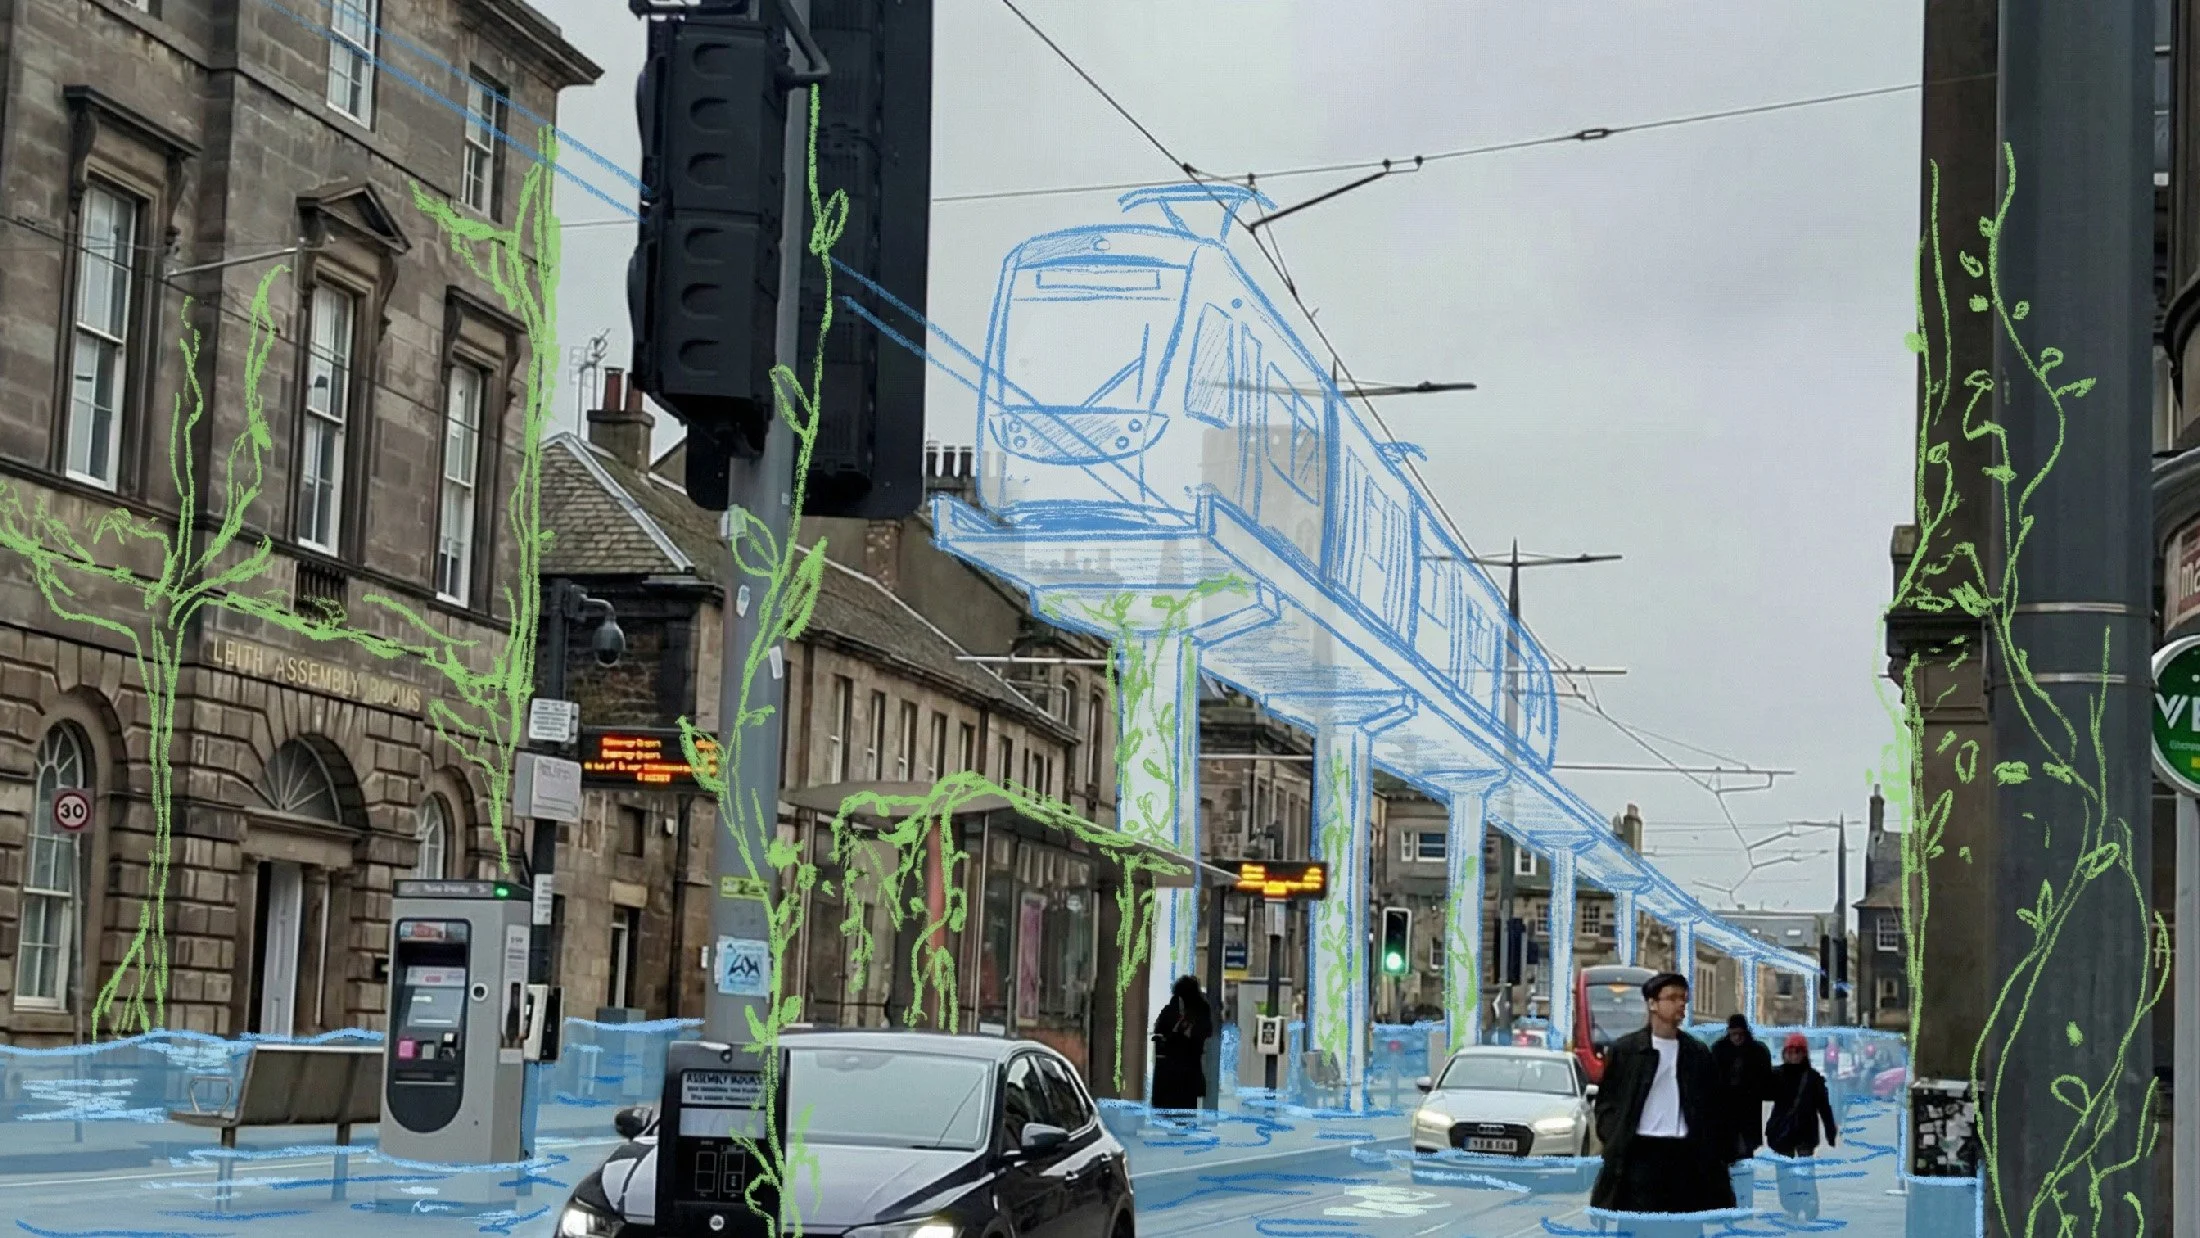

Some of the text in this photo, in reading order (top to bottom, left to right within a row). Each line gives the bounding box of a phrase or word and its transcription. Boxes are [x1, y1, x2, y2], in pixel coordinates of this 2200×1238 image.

[213, 637, 421, 713] LEITH ASSEMBLY ROOMS
[60, 803, 84, 819] 30
